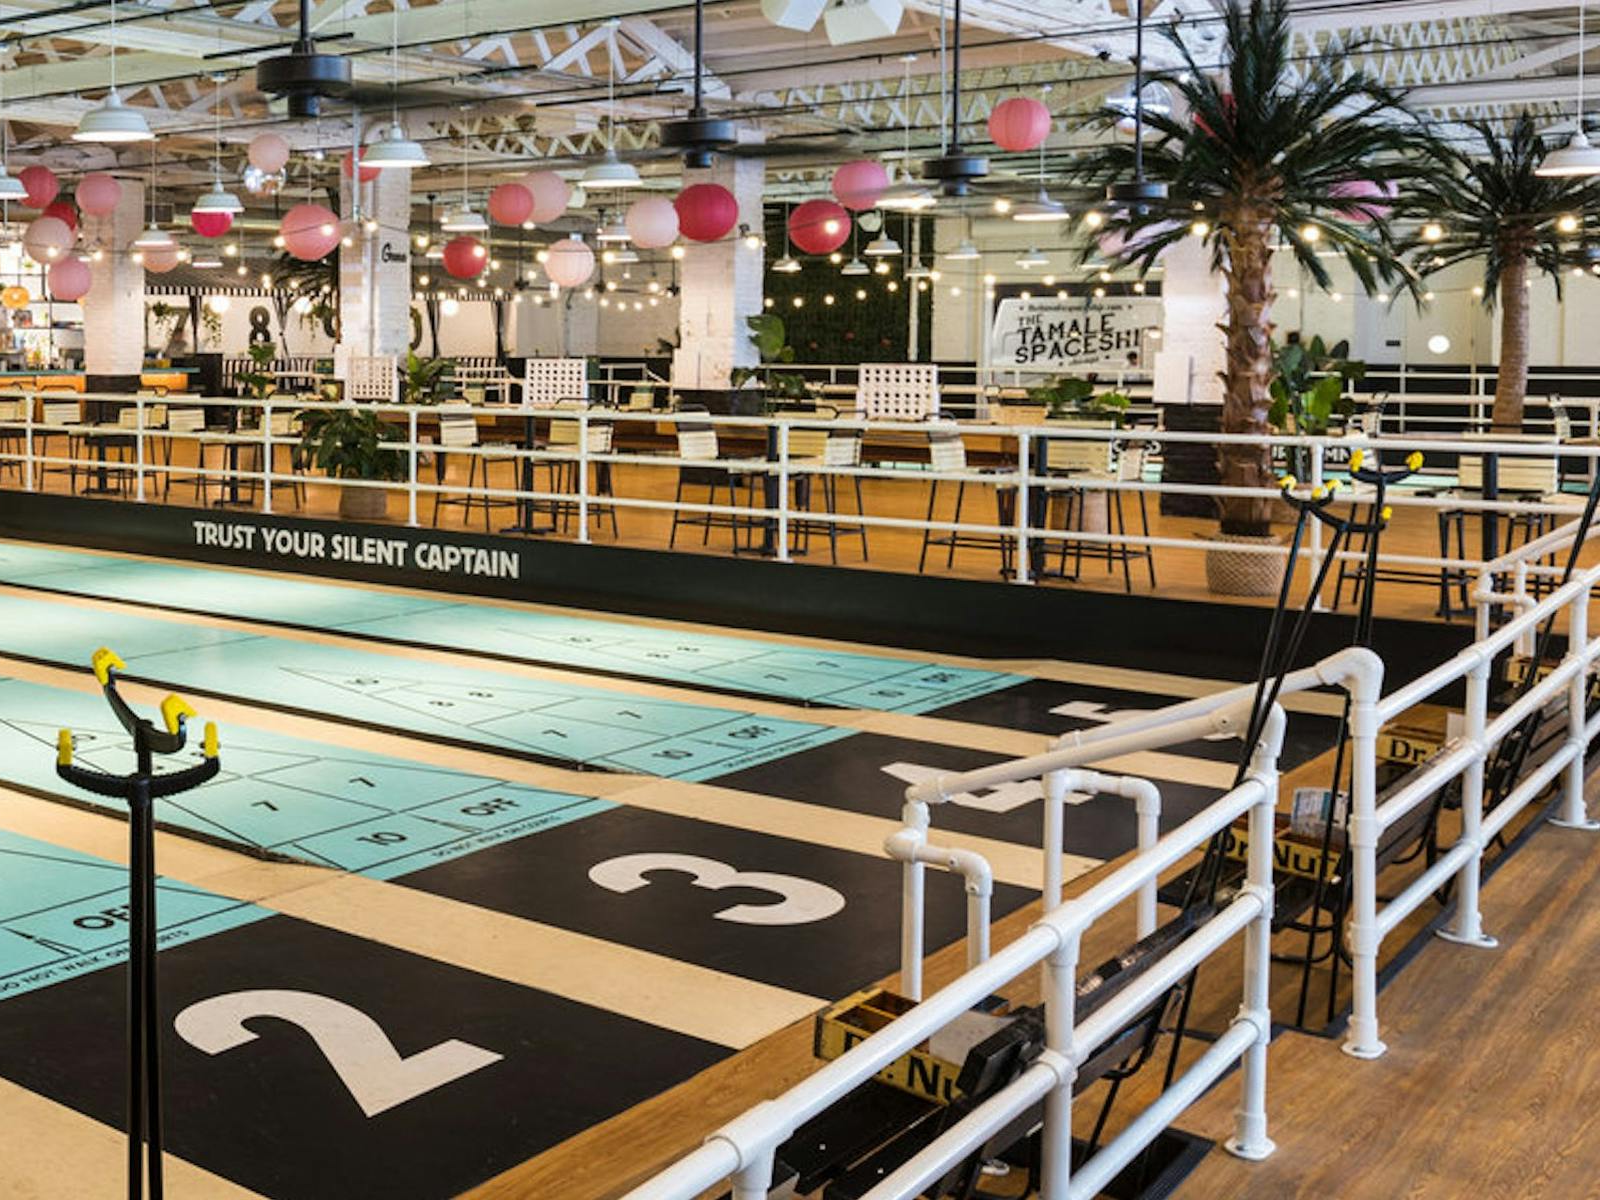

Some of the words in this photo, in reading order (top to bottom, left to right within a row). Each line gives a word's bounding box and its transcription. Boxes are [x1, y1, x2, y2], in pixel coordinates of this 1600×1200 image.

[250, 305, 270, 344] 8
[1017, 313, 1116, 345] TAMALE
[193, 521, 256, 550] TRUST
[261, 527, 326, 558] YOUR
[331, 535, 409, 566] SILENT
[415, 543, 521, 579] CAPTAIN
[348, 776, 377, 788] 7
[251, 800, 279, 812] 7
[460, 797, 520, 816] OFF
[356, 831, 408, 846] 10
[589, 852, 846, 926] 3
[73, 904, 130, 930] OF
[174, 989, 504, 1118] 2
